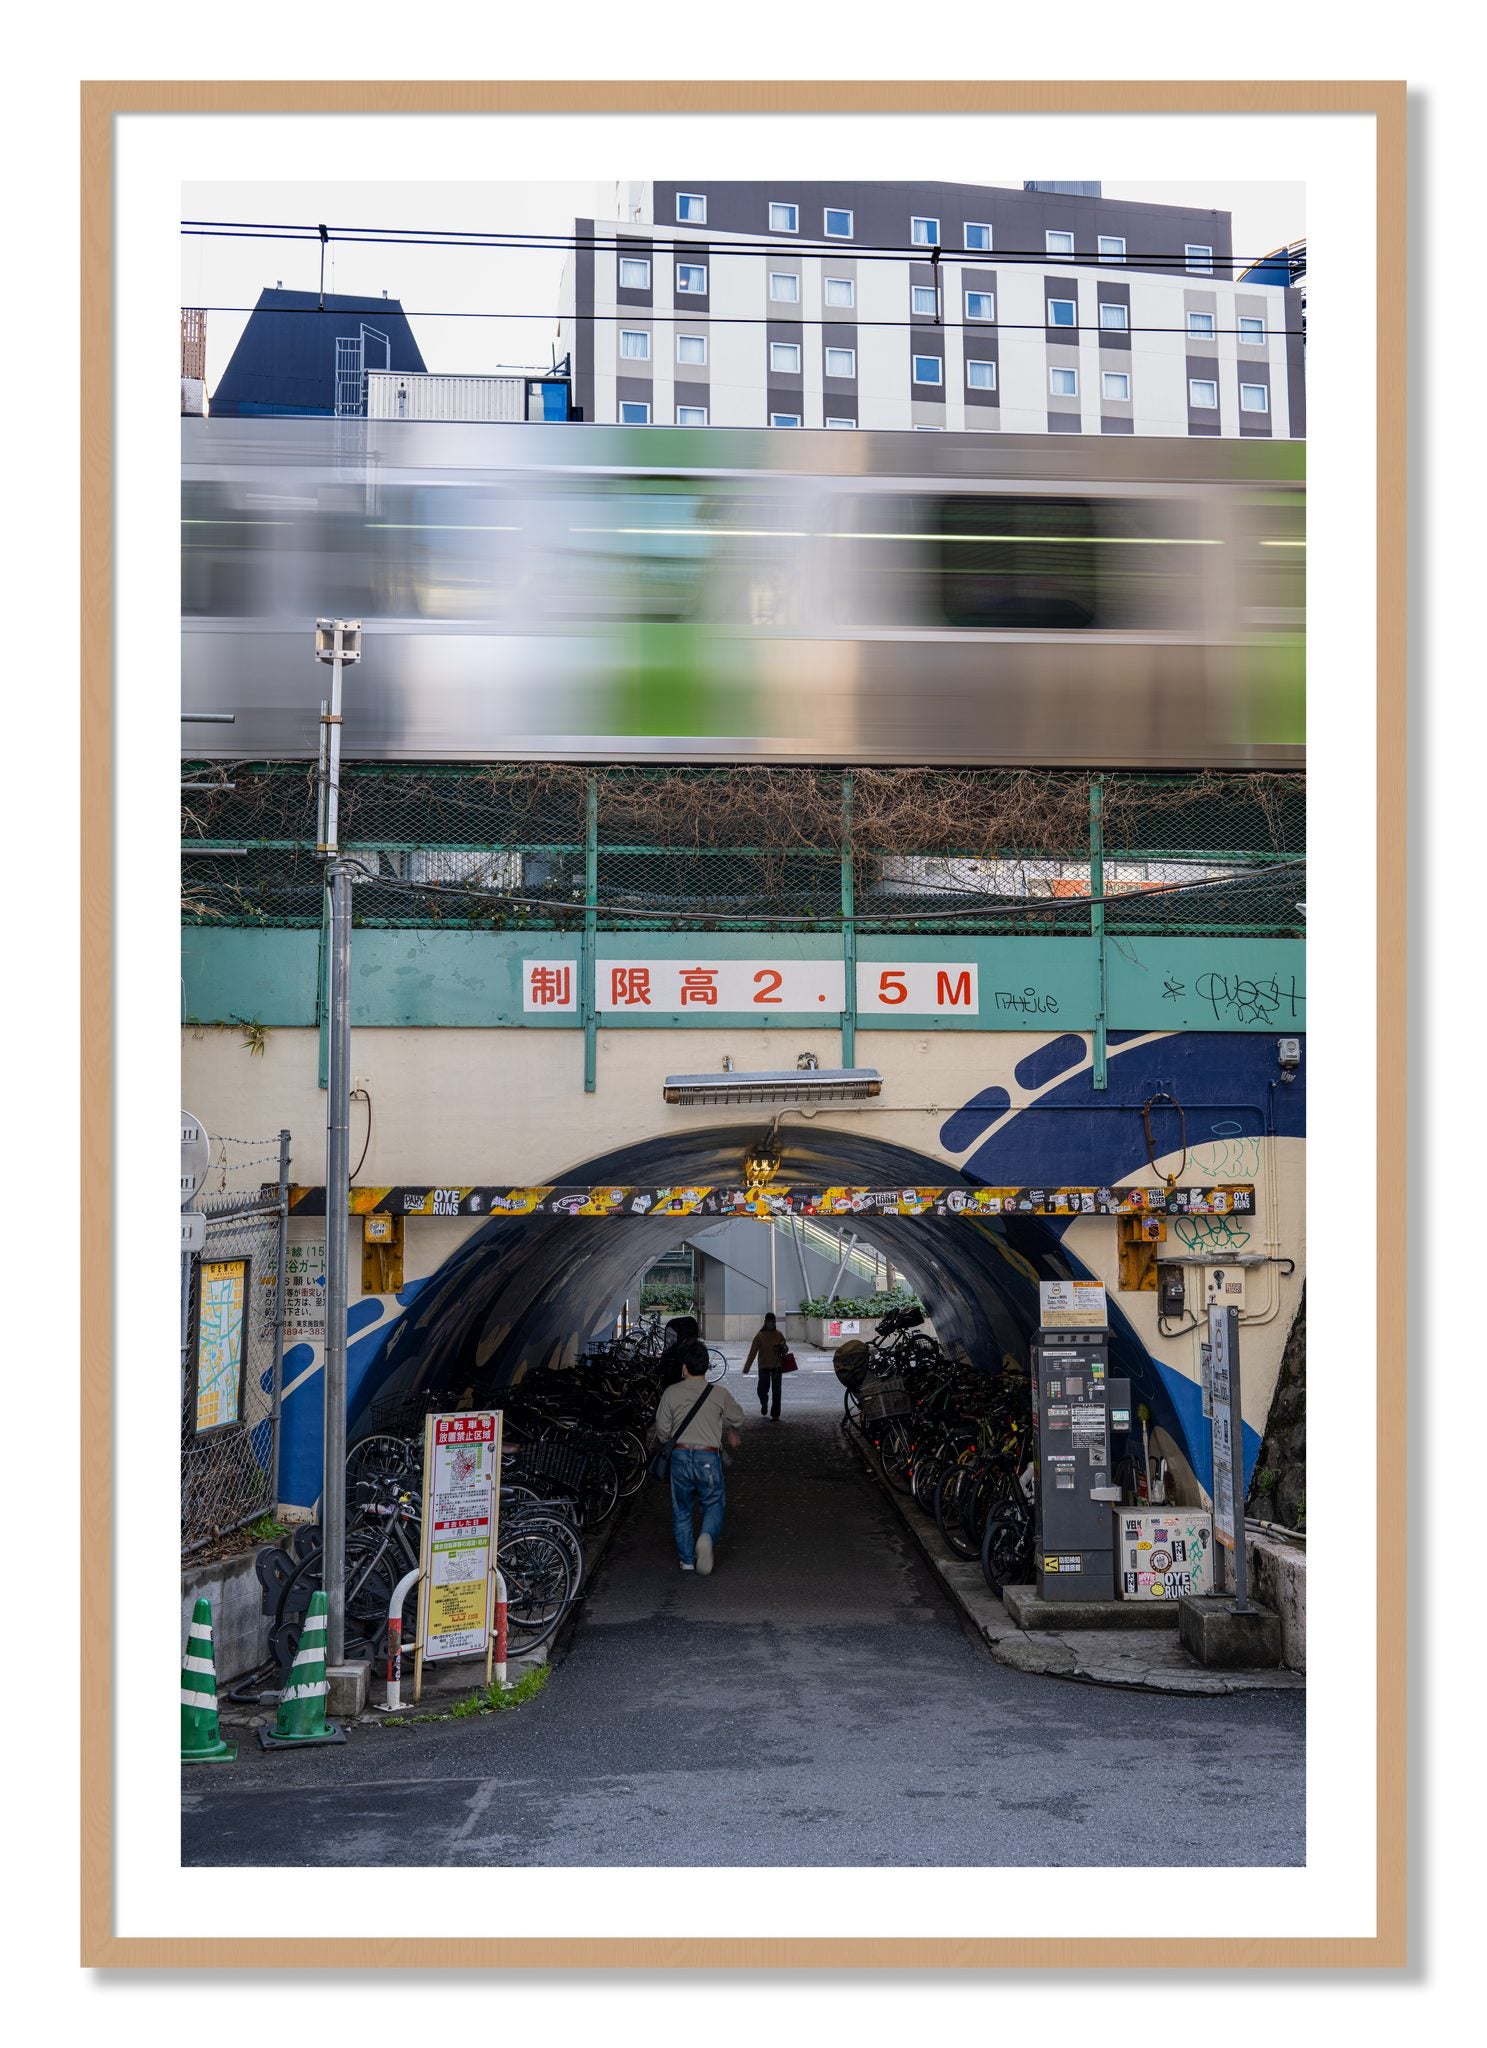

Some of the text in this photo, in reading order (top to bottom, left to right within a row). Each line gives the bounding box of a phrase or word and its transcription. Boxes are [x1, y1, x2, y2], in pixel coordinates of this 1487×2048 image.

[530, 966, 972, 1006] 制限高2.5M
[434, 1189, 460, 1203] OYE
[1233, 1191, 1250, 1201] OYE
[432, 1202, 459, 1216] RUNS
[439, 1430, 492, 1443] 放置禁止区域
[1164, 1572, 1190, 1586] OYE
[1165, 1585, 1191, 1599] RUNS
